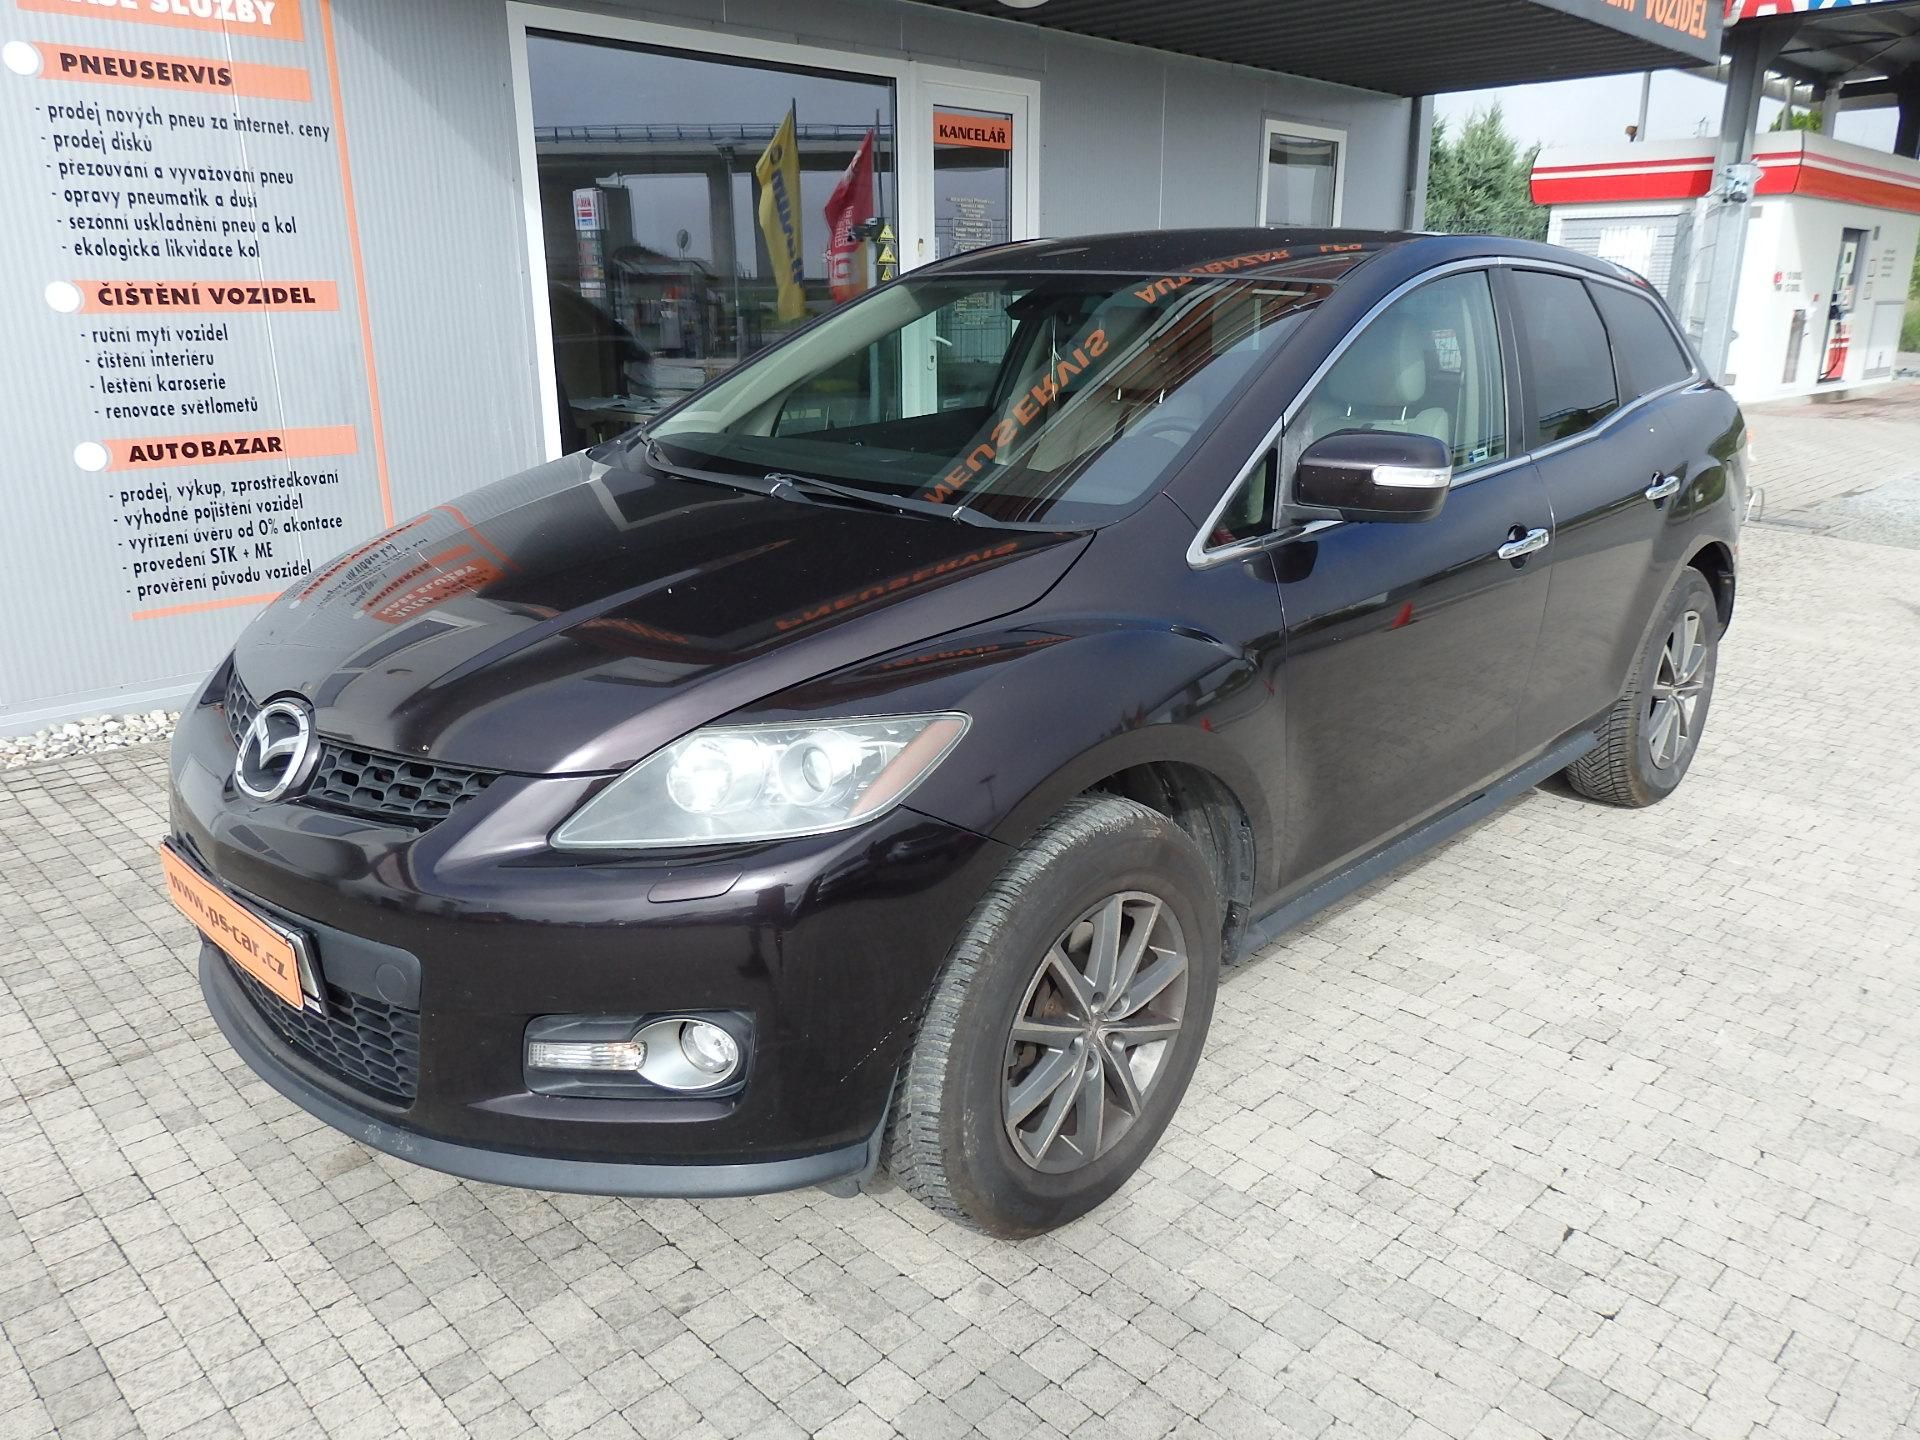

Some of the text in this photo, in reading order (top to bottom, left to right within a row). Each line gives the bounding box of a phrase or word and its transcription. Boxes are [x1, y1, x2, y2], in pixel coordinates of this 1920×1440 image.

[59, 52, 232, 86] PNEUSERVIS
[47, 100, 330, 142] prodej nových pneu za internet. ceny
[939, 124, 1006, 143] KANCELÁŘ
[53, 129, 106, 155] prodej
[154, 167, 163, 179] a
[260, 171, 294, 188] pneu
[64, 189, 120, 209] opravy
[127, 188, 209, 209] pneumatik
[215, 195, 224, 207] a
[134, 212, 217, 232] uskladnění
[222, 220, 256, 237] pneu
[261, 221, 270, 233] a
[274, 215, 297, 234] kol
[74, 236, 260, 261] ekologická likvidace kol
[98, 282, 316, 306] ČIŠTĚNÍ VOZIDEL
[92, 326, 131, 343] ruční
[176, 322, 229, 341] vozidel
[97, 349, 214, 368] čištění interiéru
[100, 372, 226, 394] leštění karoserie
[105, 396, 258, 419] renovace světlometů
[129, 436, 283, 463] AUTOBAZAR
[120, 469, 339, 507] prodej, výkup, zprostředkování
[124, 492, 303, 530] výhodné pojištění vozidel
[193, 527, 233, 543] úvěru
[238, 520, 254, 538] od
[259, 518, 278, 536] 0%
[283, 516, 343, 533] akontace
[133, 550, 206, 579] provedení
[210, 545, 238, 564] STK
[255, 541, 273, 559] ME
[137, 572, 207, 602] prověření
[211, 566, 260, 591] původu
[265, 558, 312, 580] vozidel
[169, 872, 287, 980] www.ps-car.cz
